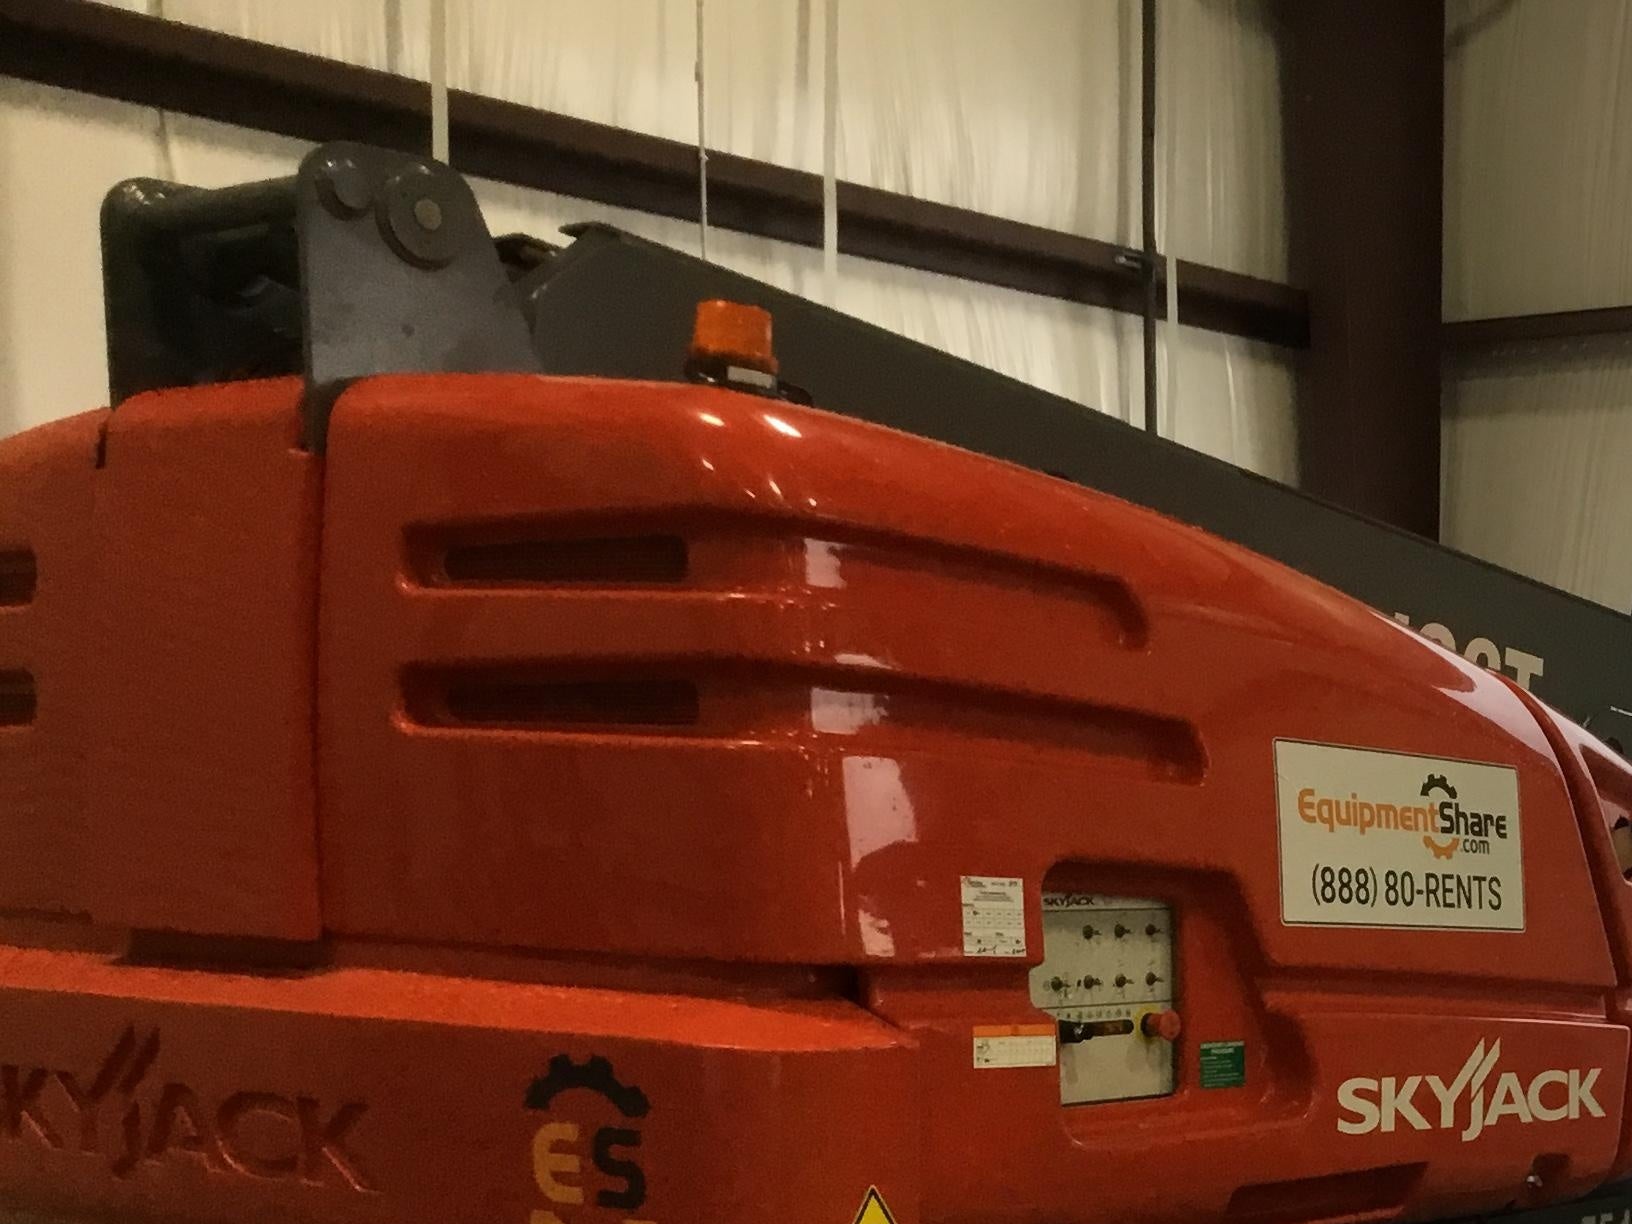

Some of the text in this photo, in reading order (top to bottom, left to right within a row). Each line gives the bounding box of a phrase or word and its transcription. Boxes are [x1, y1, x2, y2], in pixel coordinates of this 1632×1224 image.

[1297, 788, 1508, 839] EquipmentShare
[1460, 838, 1490, 855] .com
[1044, 893, 1095, 907] SKYJACK
[1312, 863, 1502, 911] (888) 80-RENTS
[0, 1024, 382, 1196] KYJACK
[1336, 1036, 1606, 1142] SKYJACK
